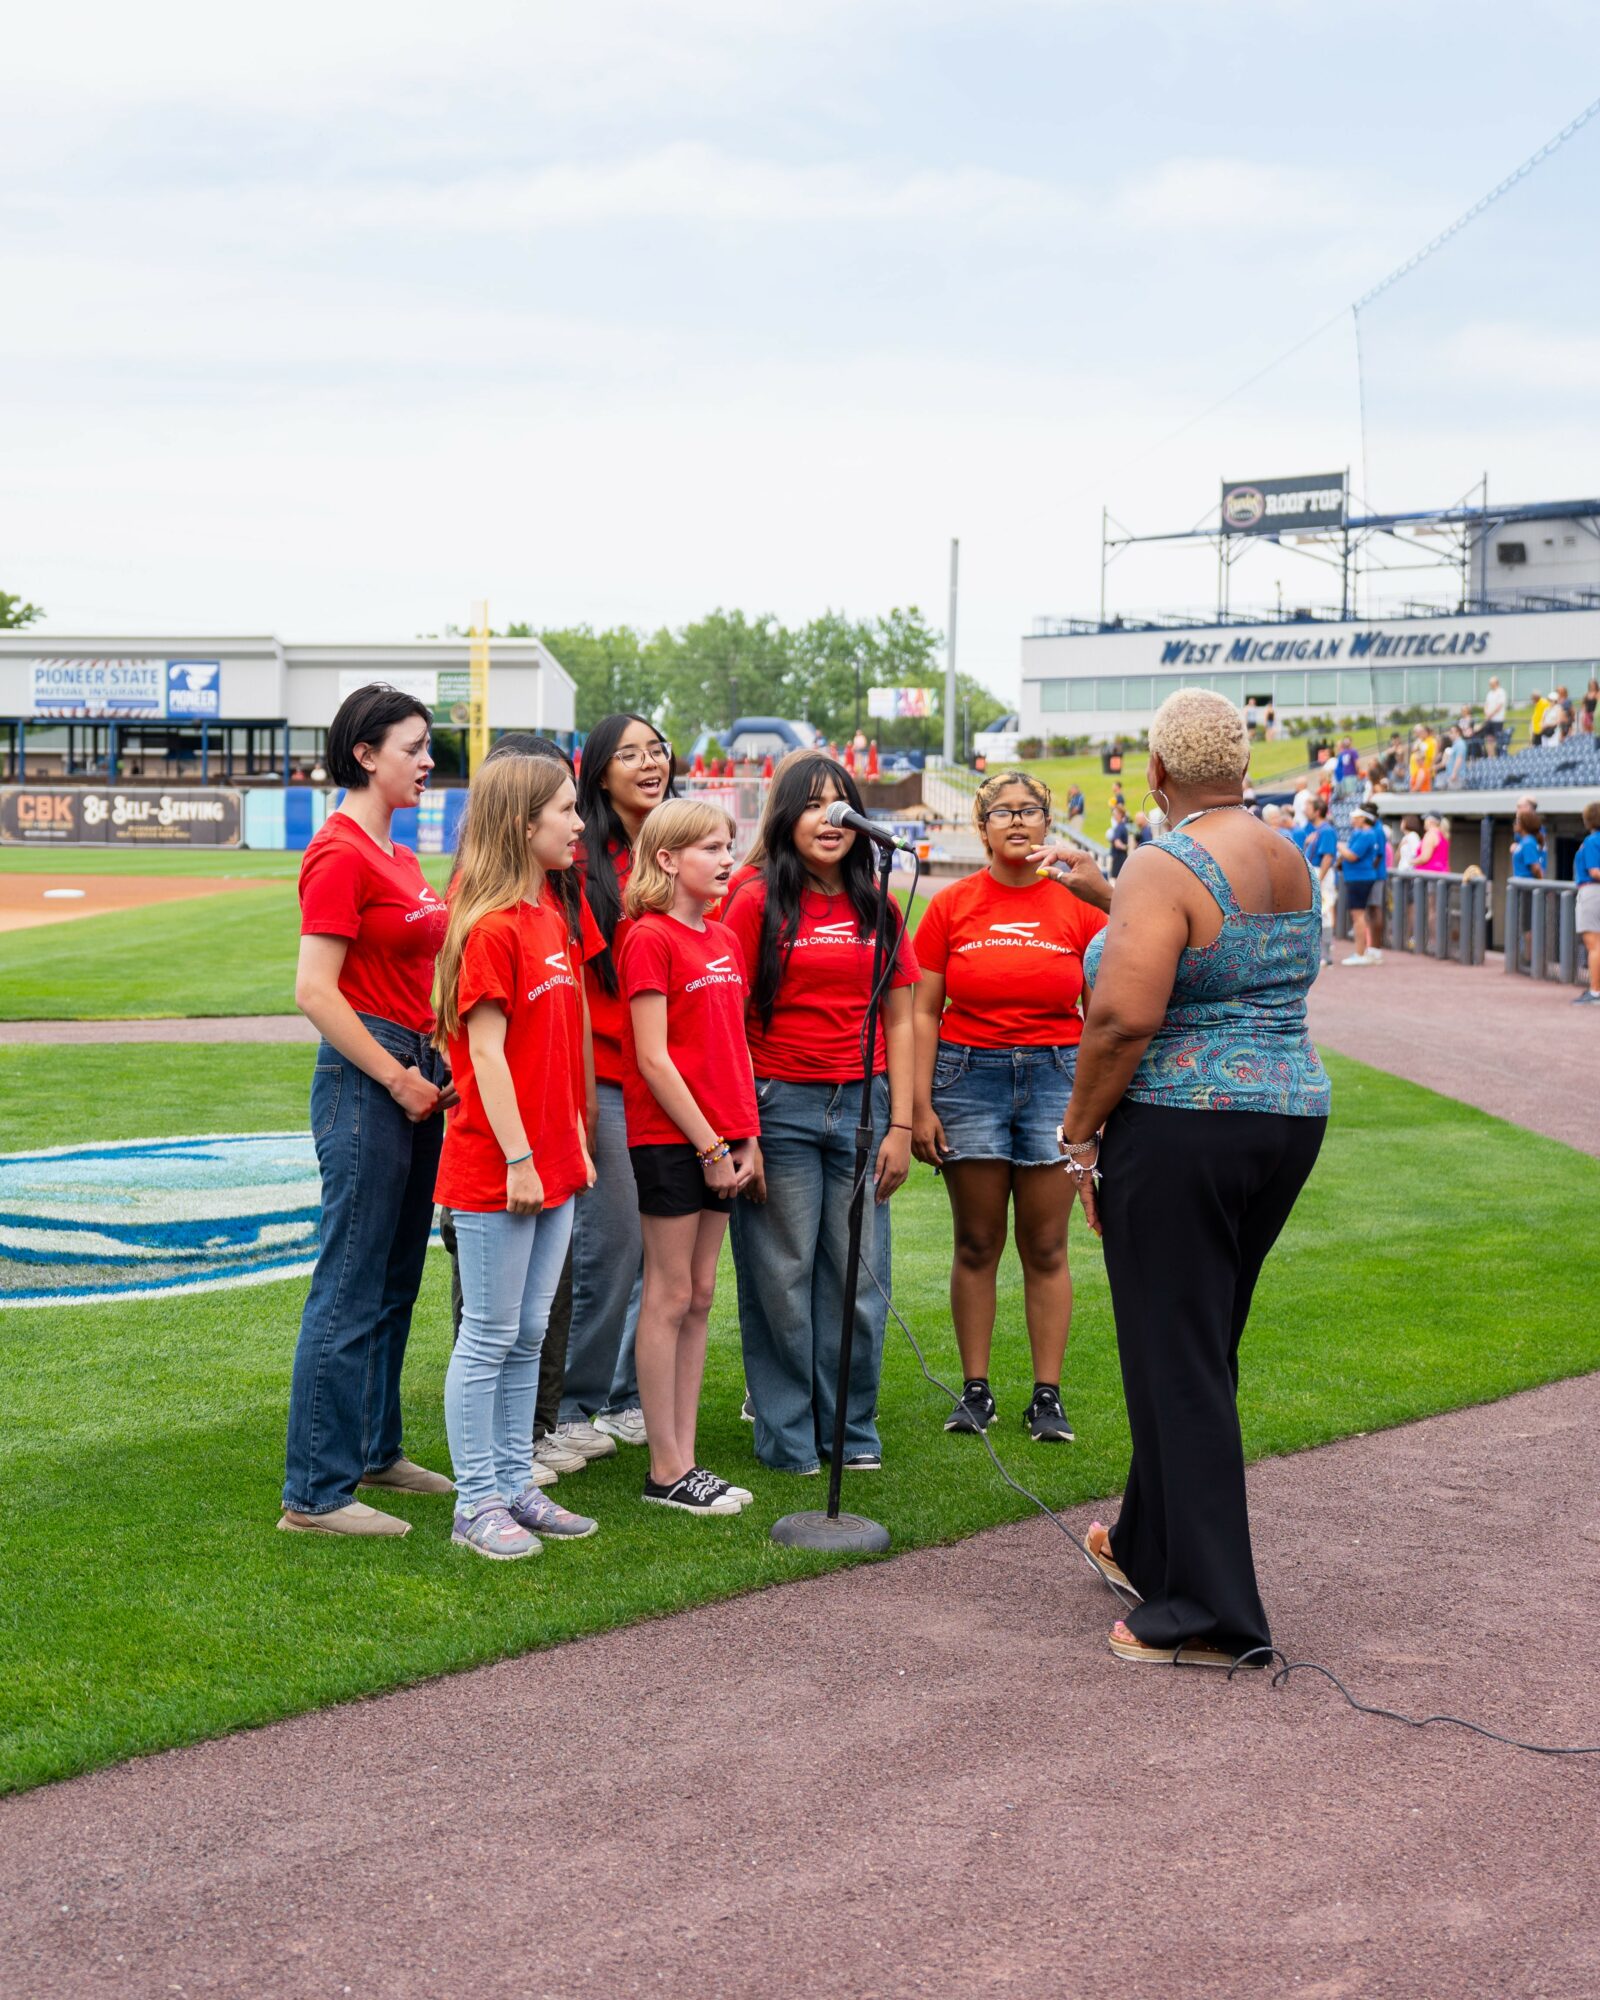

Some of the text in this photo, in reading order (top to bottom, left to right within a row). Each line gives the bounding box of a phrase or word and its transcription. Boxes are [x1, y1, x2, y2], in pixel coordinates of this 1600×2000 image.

[1265, 488, 1342, 516] ROOFTOP
[1160, 630, 1491, 665] WEST MICHIGAN WHITECAPS
[34, 668, 159, 685] PIONEER STATE
[34, 687, 158, 697] MUTUAL INSURANCE
[169, 689, 217, 707] PIONEER
[17, 794, 74, 821] CBK
[405, 907, 425, 923] GIRLS
[783, 938, 808, 949] GRLS
[809, 937, 845, 945] CHORAL
[957, 938, 1073, 954] GIRLS CHORAL ACADEMY
[528, 980, 551, 1001] GIRLS
[685, 976, 706, 993] GIRLS
